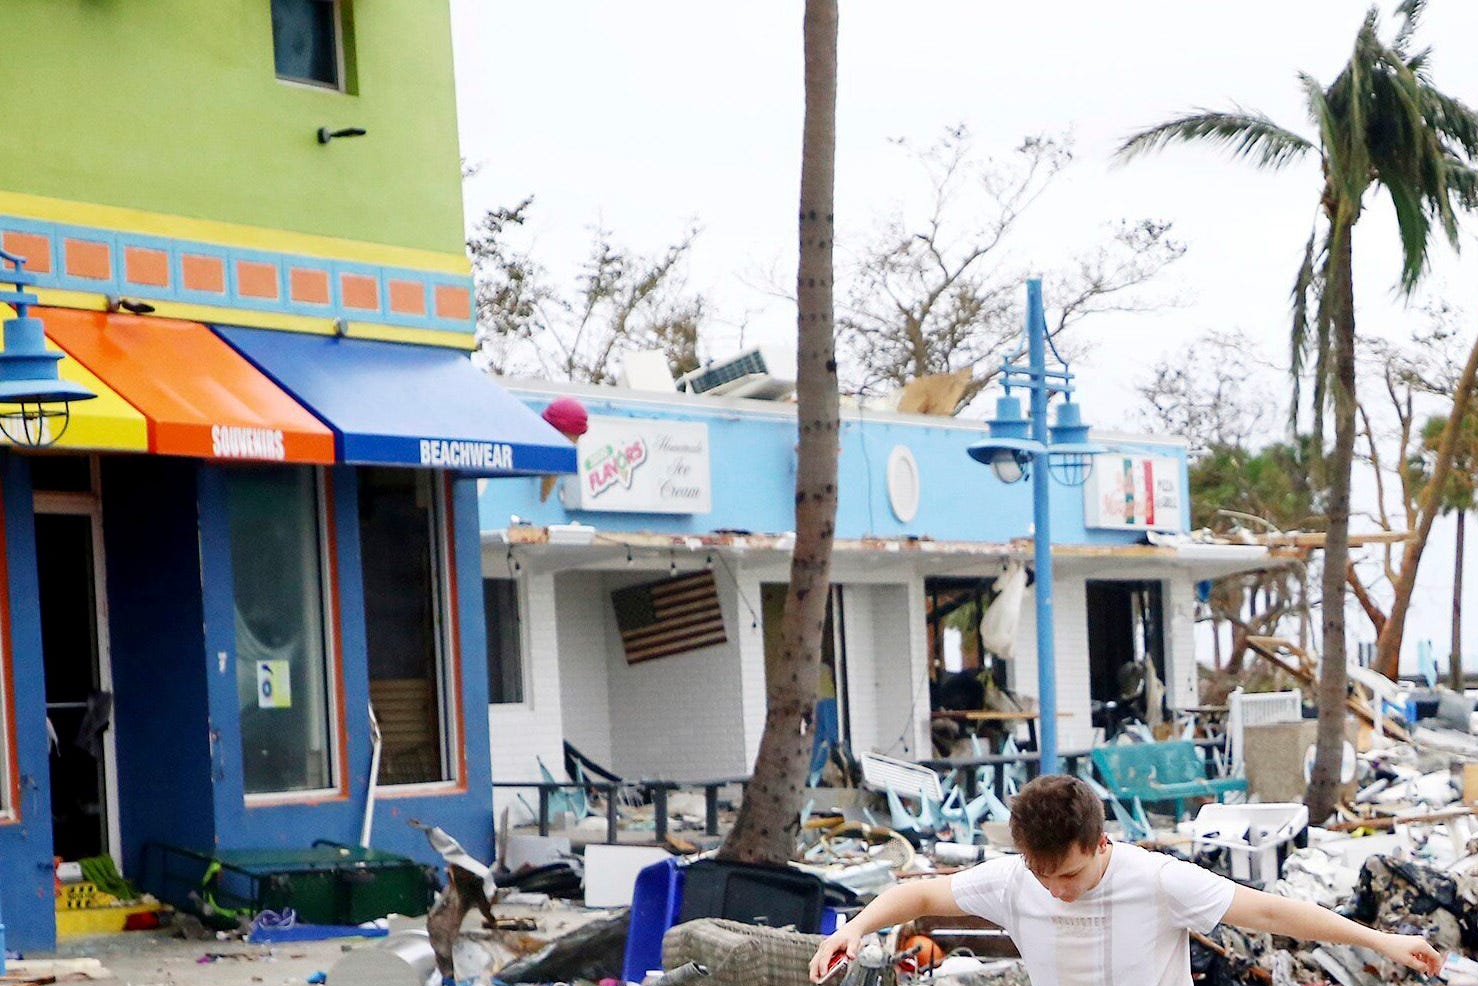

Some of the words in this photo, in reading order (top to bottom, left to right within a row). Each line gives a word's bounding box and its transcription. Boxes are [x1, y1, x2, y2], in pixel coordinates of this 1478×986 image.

[211, 423, 286, 461] SOUVENIRS
[419, 438, 513, 469] BEACHWEAR
[589, 440, 644, 492] FLAVORS
[660, 479, 701, 499] Cream
